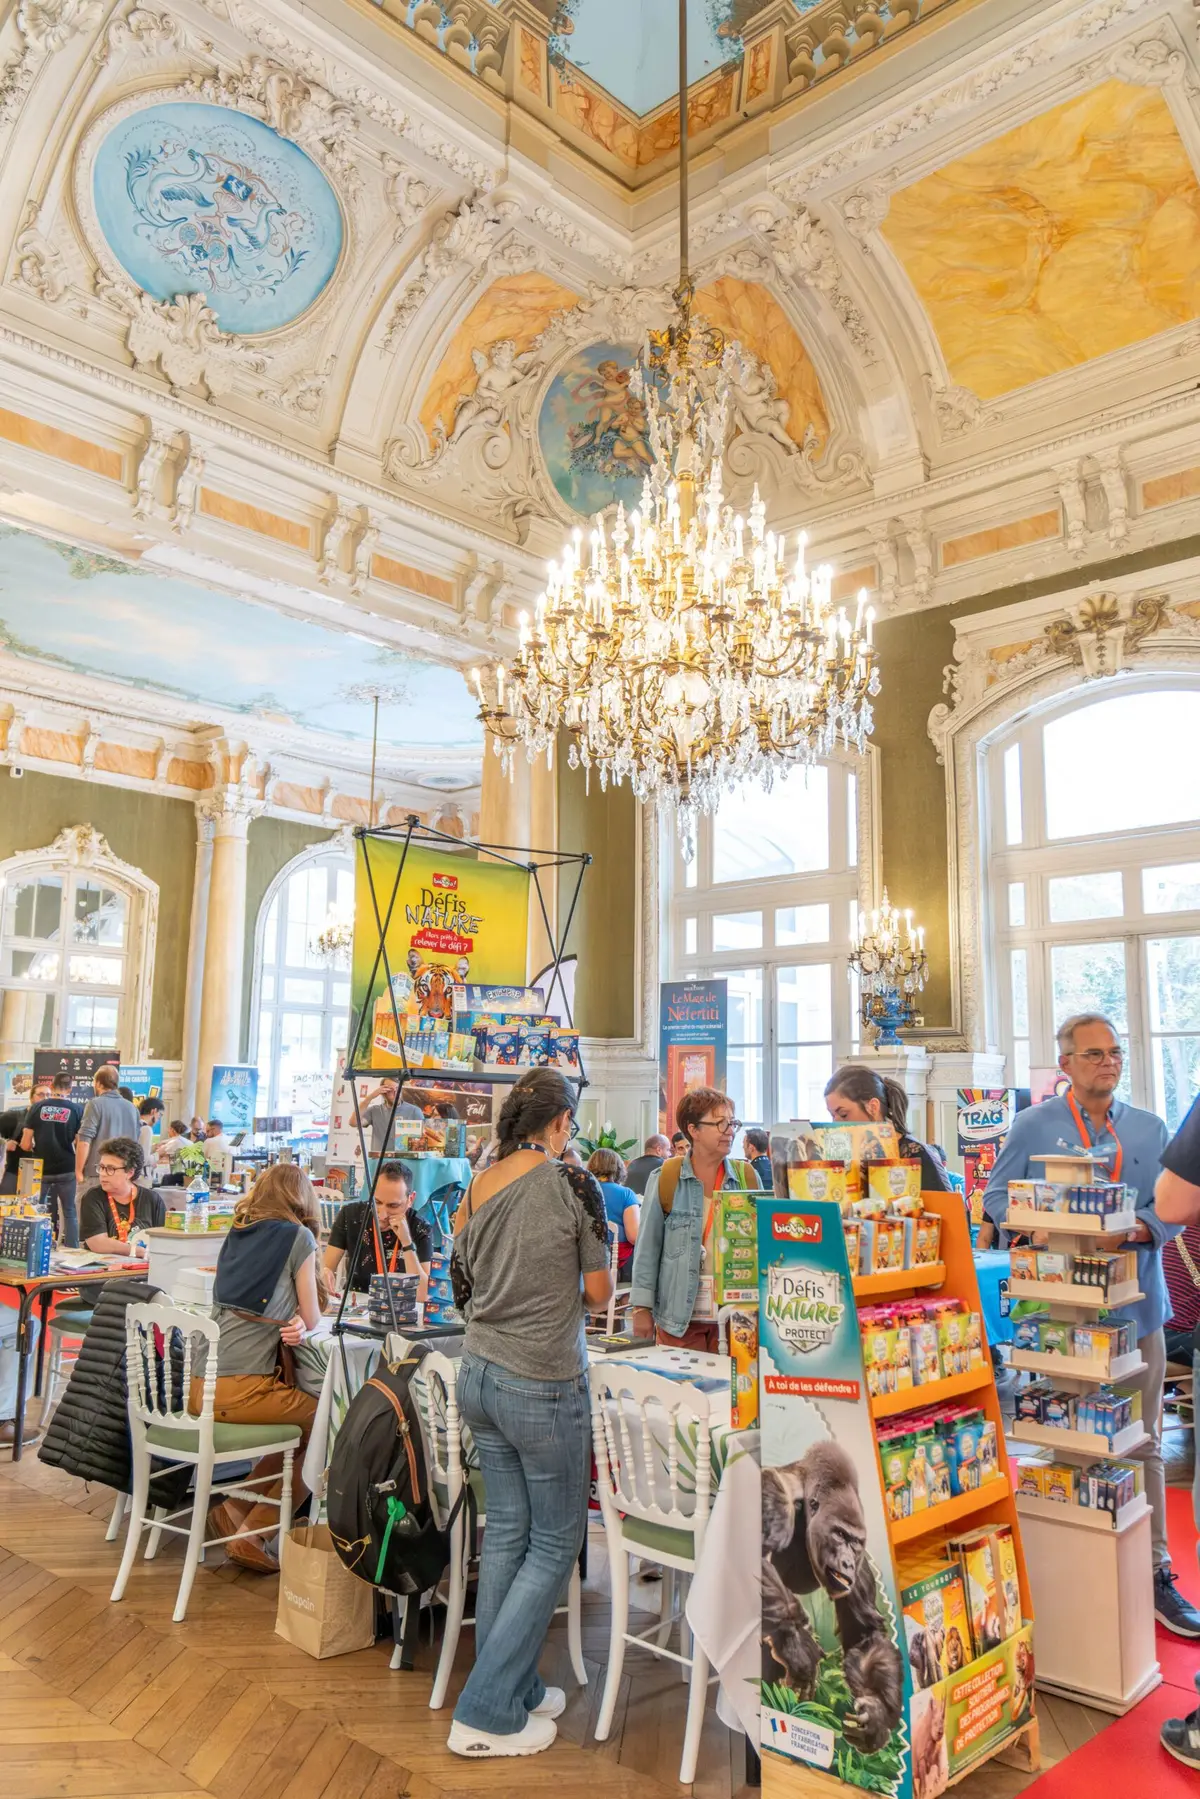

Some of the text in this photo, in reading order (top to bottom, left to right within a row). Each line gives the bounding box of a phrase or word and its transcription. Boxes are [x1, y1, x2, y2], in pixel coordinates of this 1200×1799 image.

[421, 888, 466, 913] Défis
[405, 904, 484, 935] NATURE
[414, 938, 468, 952] relever le défi ?
[672, 991, 716, 1004] Le Mage de
[668, 1005, 719, 1022] Néfertiti
[467, 1104, 486, 1116] Fall
[963, 1110, 1004, 1126] TRAQ
[774, 1221, 819, 1236] bioviva!
[783, 1278, 825, 1299] Défis
[766, 1295, 842, 1325] NATURE
[785, 1328, 826, 1341] PROTECT
[768, 1379, 857, 1394] À toi de les défendre !
[791, 1724, 820, 1740] CONCEPTION
[956, 1735, 964, 1751] DE
[964, 1709, 998, 1742] PROTECTION
[791, 1732, 829, 1751] ET FABRICATION
[791, 1740, 817, 1755] FRANÇAISE
